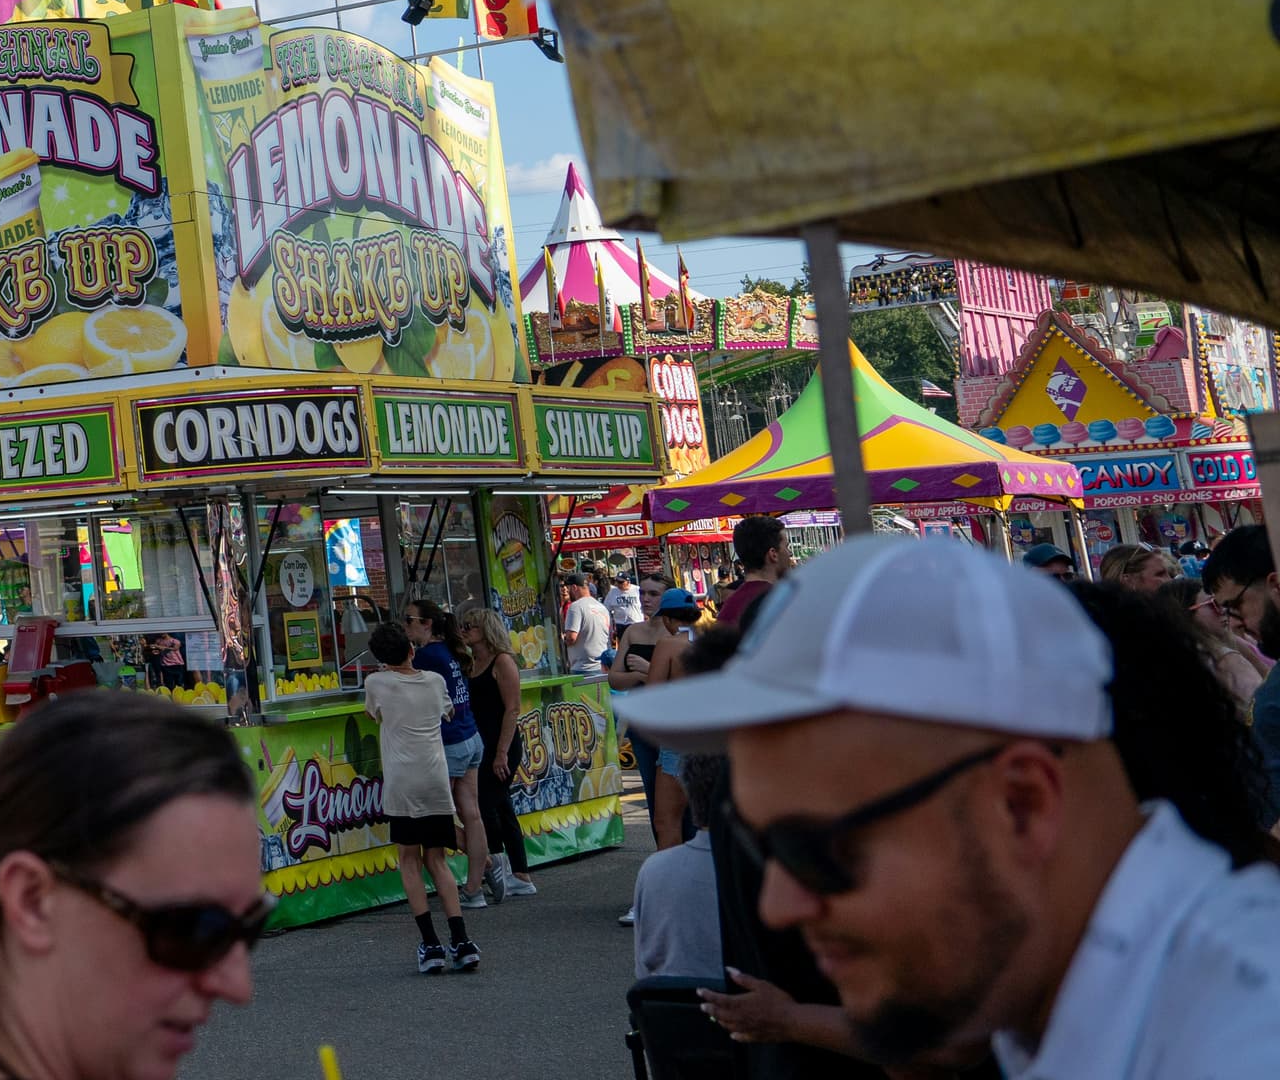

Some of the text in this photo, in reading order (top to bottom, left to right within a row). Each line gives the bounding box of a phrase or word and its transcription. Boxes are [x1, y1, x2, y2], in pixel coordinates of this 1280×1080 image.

[209, 79, 262, 105] LEMONADE
[276, 35, 425, 120] THE ORIGINAL
[441, 117, 484, 158] LEMONADE
[228, 88, 496, 301] LEMONADE
[62, 229, 155, 301] UP
[272, 231, 413, 330] SHAKE
[411, 231, 469, 323] UP
[652, 362, 698, 401] CORN
[153, 400, 360, 464] CORNDOGS
[383, 401, 511, 456] LEMONADE
[545, 408, 644, 458] SHAKE UP
[1078, 460, 1174, 491] CANDY
[1192, 455, 1241, 484] COLD
[937, 505, 968, 516] APPLES
[1015, 501, 1046, 511] CANDY
[1093, 495, 1142, 507] POPCORN
[1152, 492, 1175, 503] SNO
[1178, 491, 1213, 501] CONES
[561, 523, 644, 540] CORN DOGS
[548, 703, 599, 769] UP
